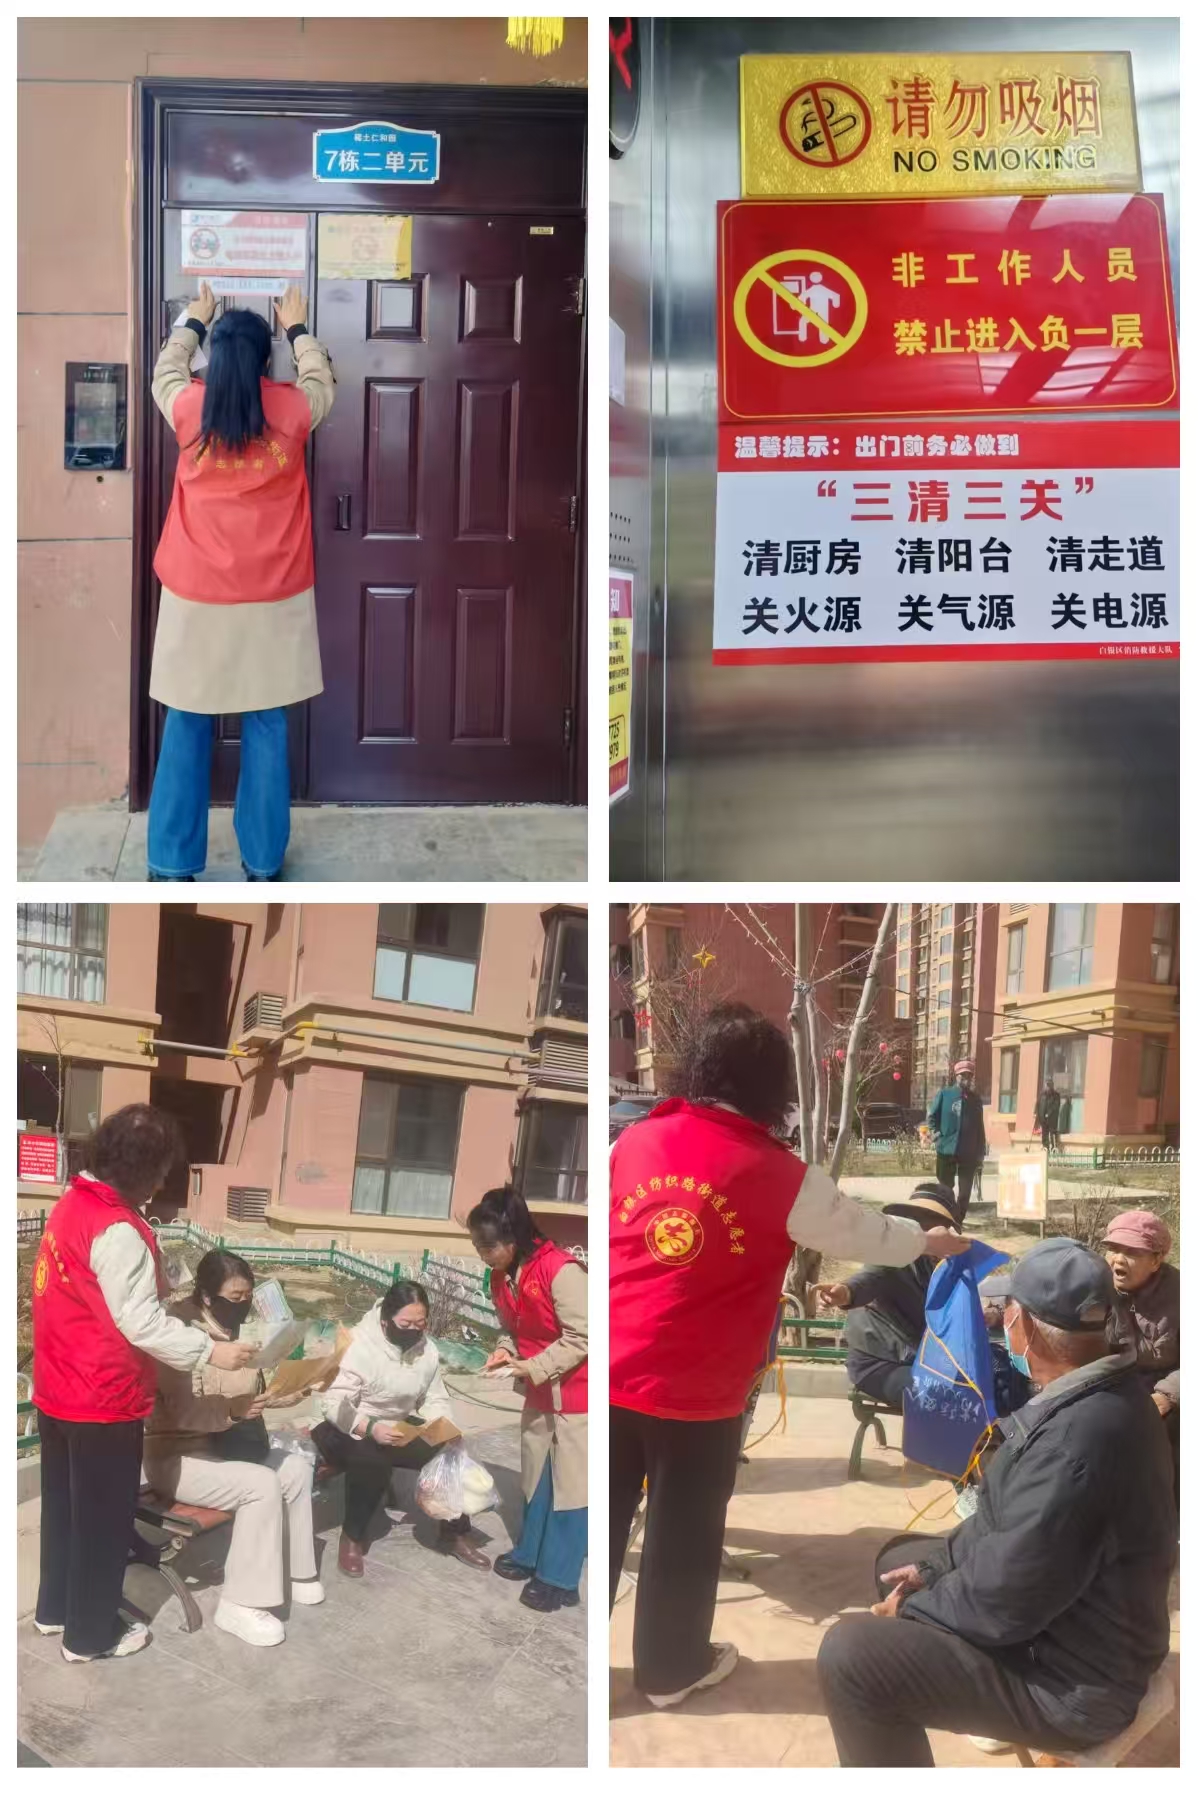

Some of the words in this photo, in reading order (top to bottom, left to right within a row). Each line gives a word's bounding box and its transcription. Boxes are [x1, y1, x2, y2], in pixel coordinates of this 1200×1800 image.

[885, 76, 1102, 139] 请勿吸烟
[323, 150, 429, 173] 7栋二单元
[893, 150, 937, 172] NO
[953, 147, 1095, 171] SMOKING
[891, 247, 1138, 288] 非工作人员
[893, 313, 1144, 356] 禁止进入负一层
[742, 538, 862, 576] 清厨房
[894, 537, 1012, 574] 清阳台
[1046, 535, 1166, 573] 清走道
[741, 595, 862, 635] 关火源
[898, 593, 1016, 632] 关气源
[1051, 592, 1169, 630] 关电源
[1099, 645, 1173, 655] 白银区消防救援大队
